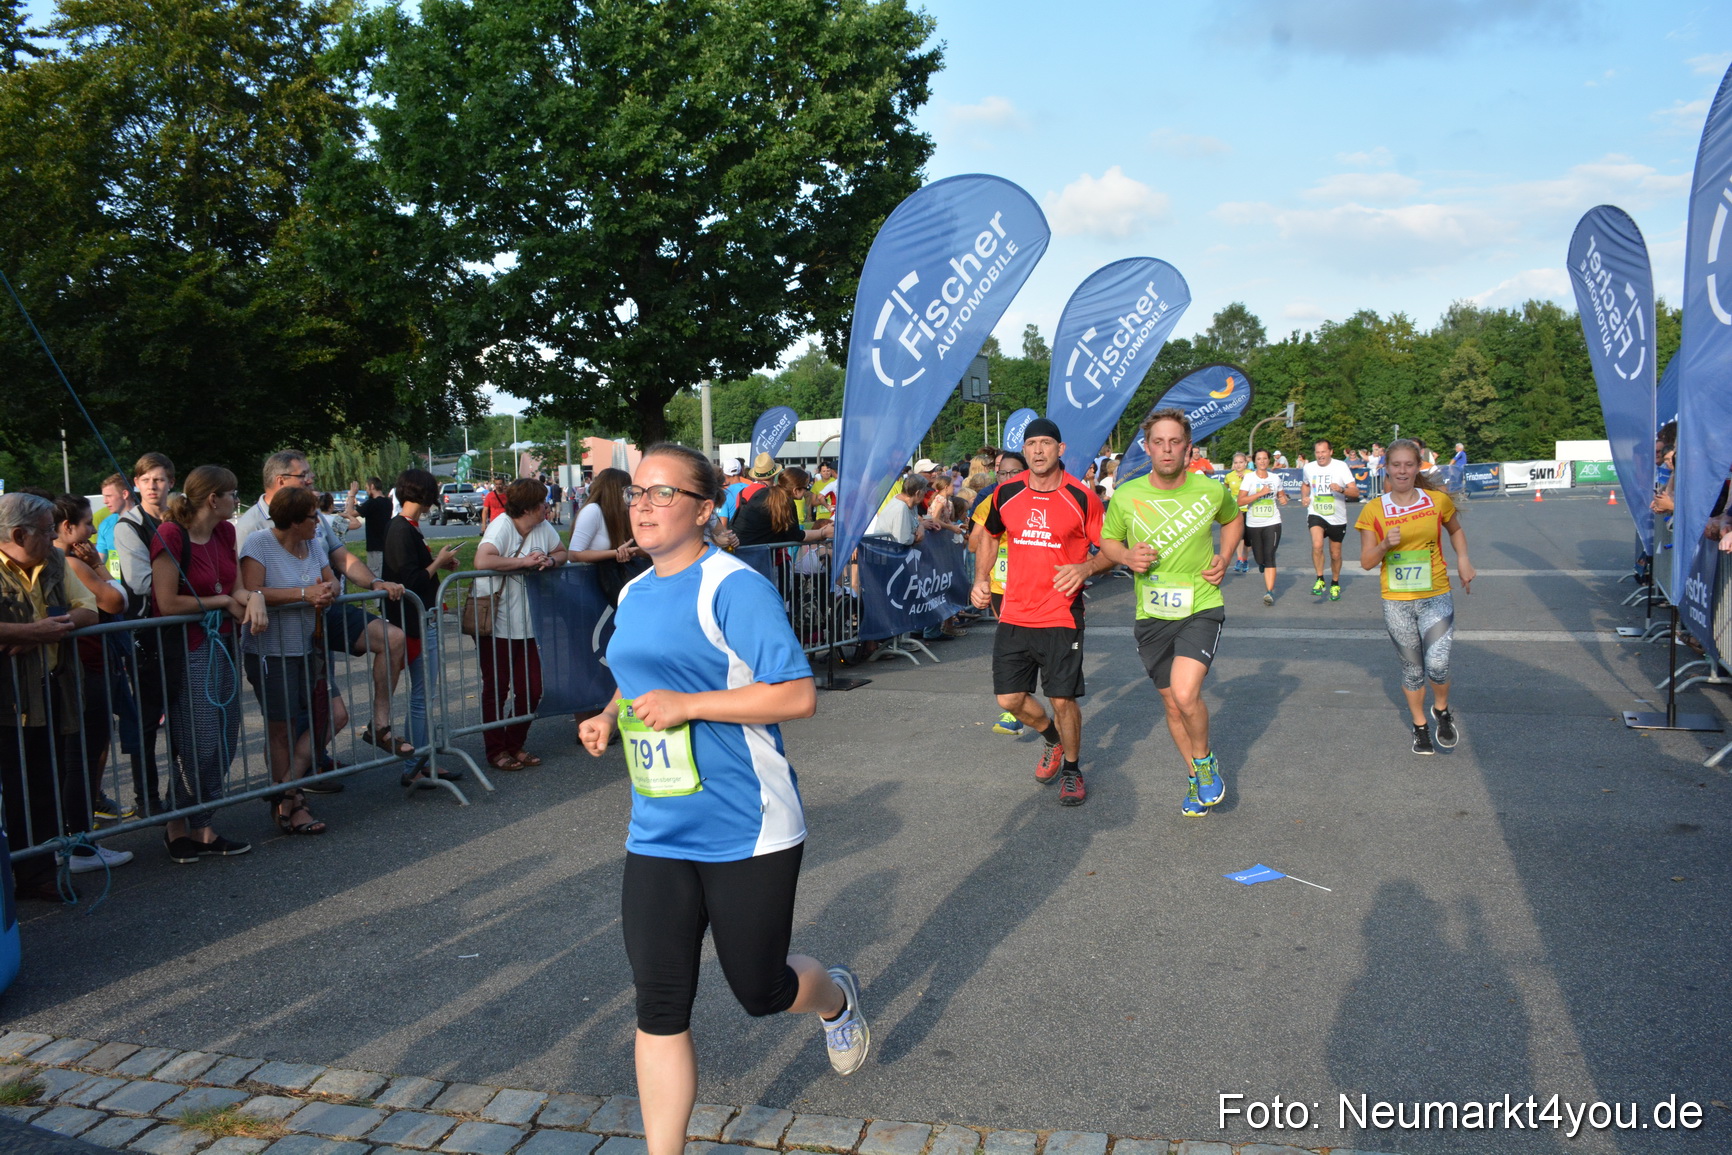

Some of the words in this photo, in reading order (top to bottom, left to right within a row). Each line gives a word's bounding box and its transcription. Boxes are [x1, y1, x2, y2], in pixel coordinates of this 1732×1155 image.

[898, 211, 1006, 361] Fischer
[937, 240, 1019, 360] AUTOMOBILE
[1083, 281, 1159, 390] Fischer
[1111, 301, 1169, 388] AUTOMOBILE
[1190, 415, 1210, 430] Druck
[1222, 394, 1247, 412] Medien
[762, 413, 788, 449] Fischer
[1011, 414, 1031, 444] Fischer
[1255, 505, 1273, 513] 1170
[1315, 503, 1333, 511] 1169
[1385, 517, 1409, 527] MAX
[1412, 509, 1438, 521] BÖGL
[1021, 529, 1052, 540] MEYER
[1160, 547, 1174, 559] UND
[1394, 566, 1422, 581] 877
[1150, 590, 1182, 608] 215
[630, 738, 671, 770] 791
